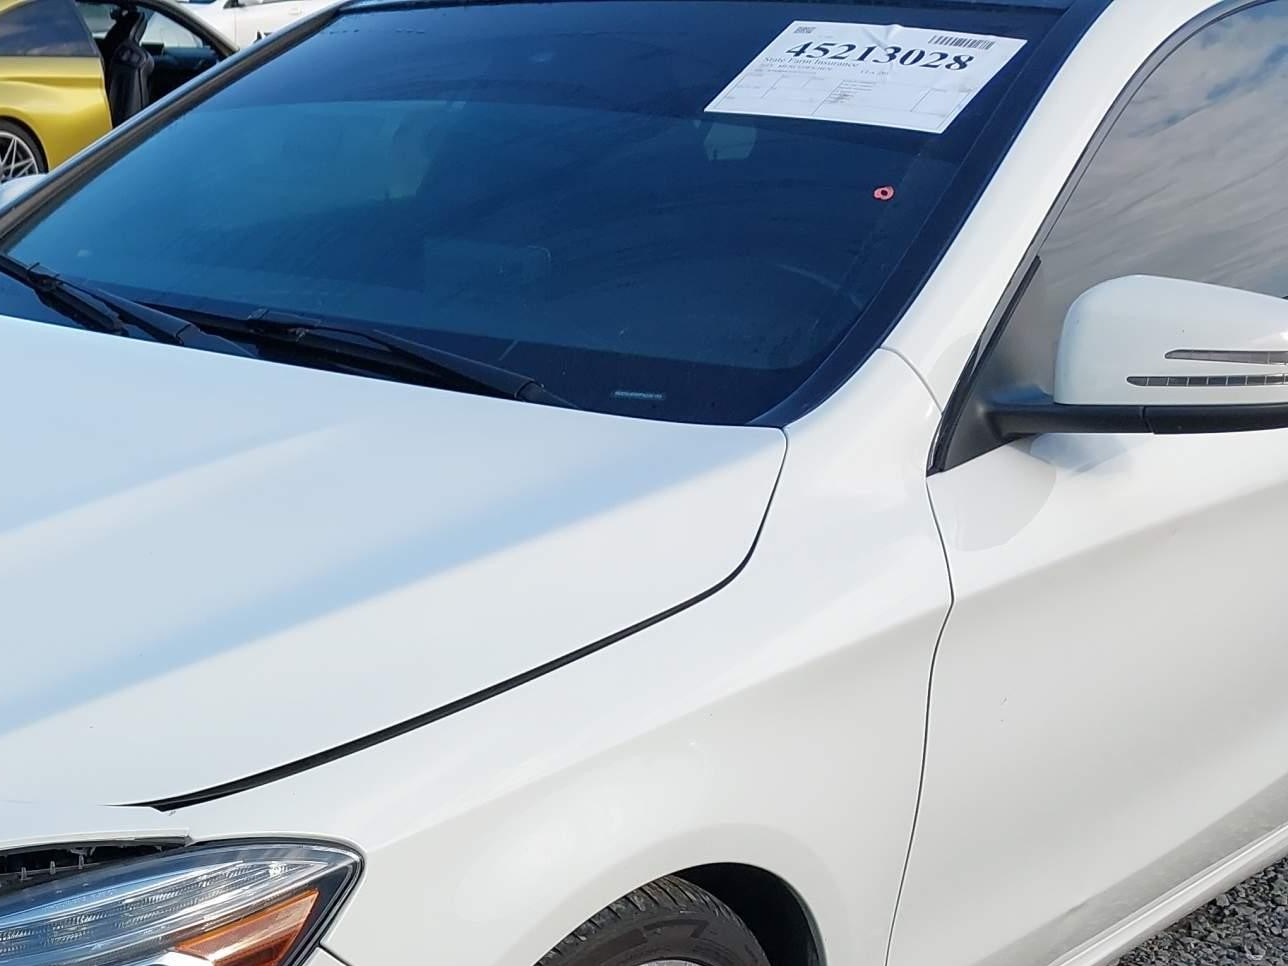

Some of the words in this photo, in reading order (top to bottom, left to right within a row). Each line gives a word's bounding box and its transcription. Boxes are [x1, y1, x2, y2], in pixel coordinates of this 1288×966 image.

[763, 56, 787, 64] State
[789, 57, 812, 65] Farm
[814, 58, 860, 68] Insurance
[786, 40, 975, 71] 45213028
